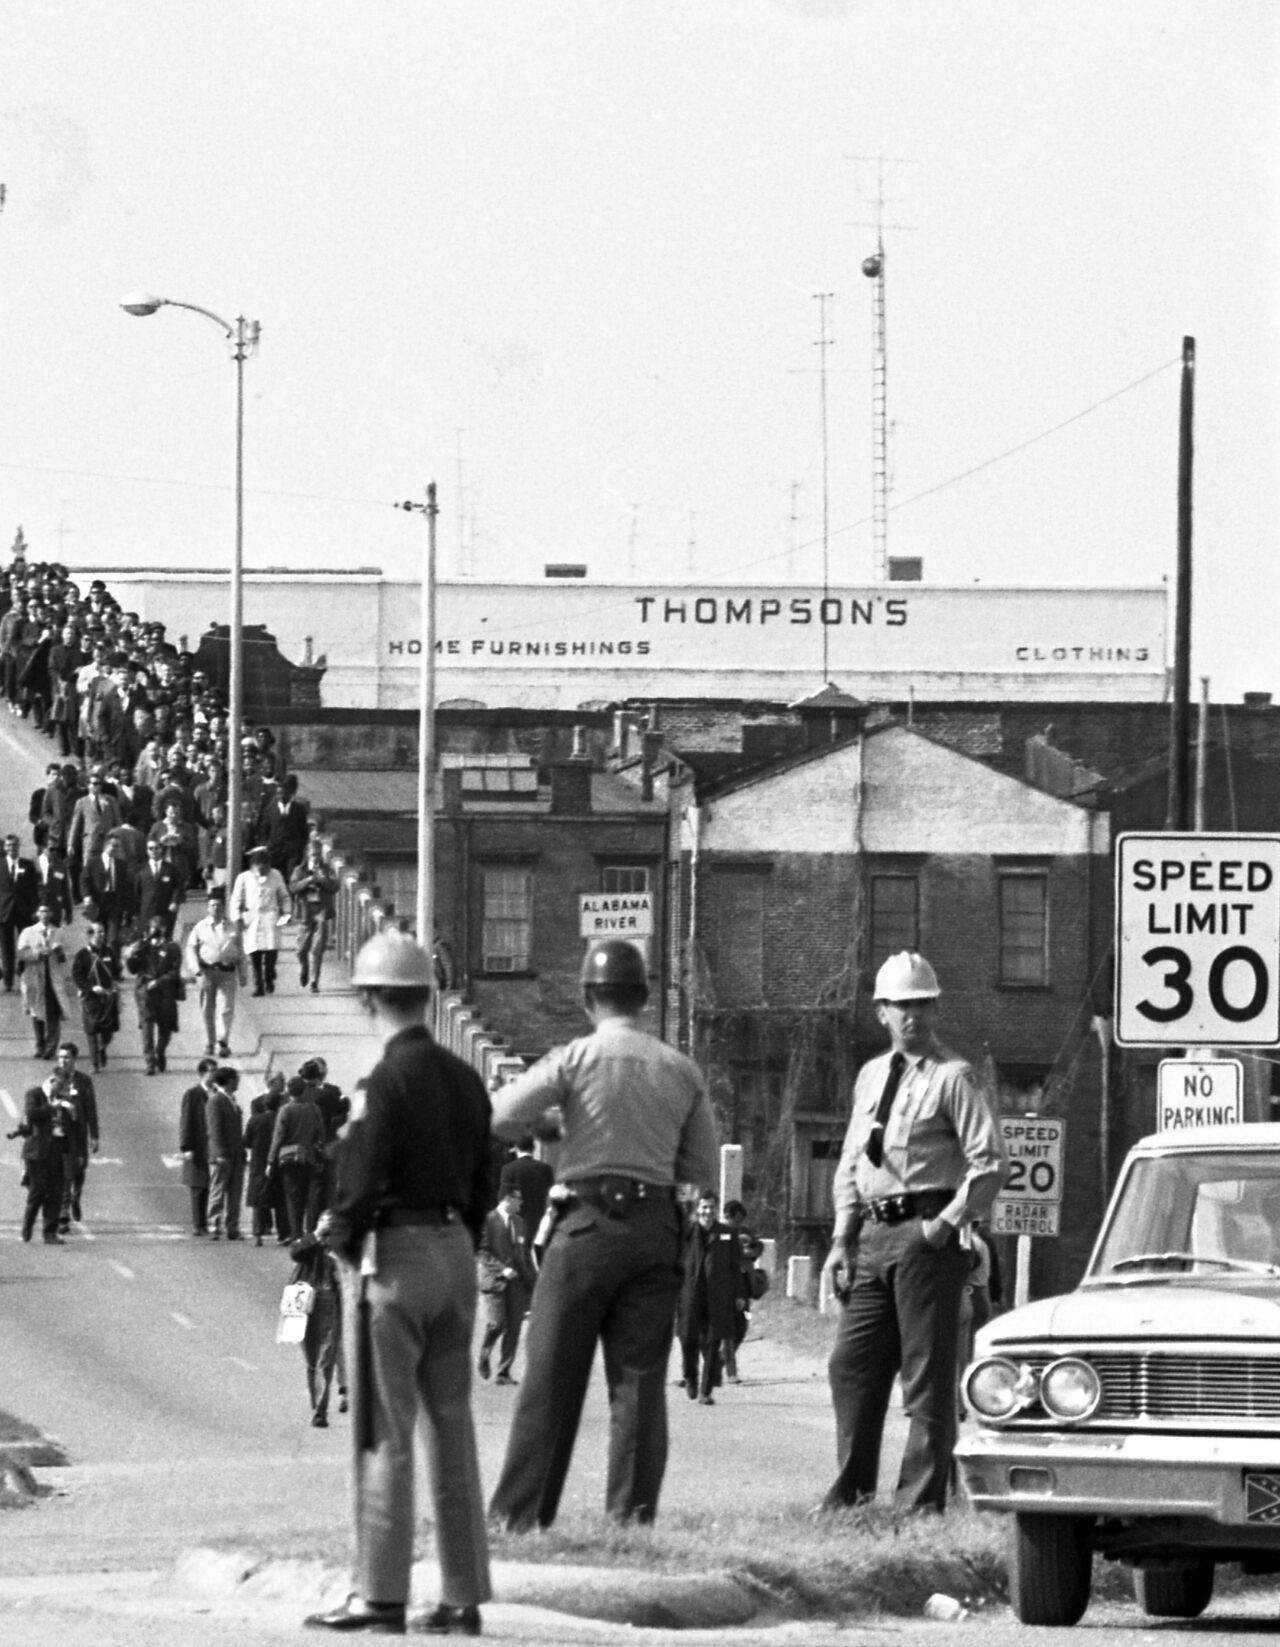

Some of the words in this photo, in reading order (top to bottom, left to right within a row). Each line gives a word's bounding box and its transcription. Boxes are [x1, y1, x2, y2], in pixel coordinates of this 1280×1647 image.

[634, 596, 908, 627] THOMPSON'S
[472, 640, 651, 656] FURNISHINGS
[1015, 647, 1149, 661] CLOTHING
[1132, 859, 1273, 892] SPEED
[583, 900, 649, 912] ALABAMA
[594, 916, 637, 929] RIVER
[1148, 903, 1254, 935] LIMIT
[1135, 945, 1269, 1023] 30
[1184, 1075, 1213, 1097] NO
[1164, 1106, 1234, 1130] PARKING
[1003, 1126, 1059, 1141] SPEED
[1009, 1145, 1050, 1158] LIMIT
[1003, 1161, 1055, 1192] 20
[1006, 1205, 1048, 1219] RADAR
[997, 1218, 1054, 1233] CONTROL
